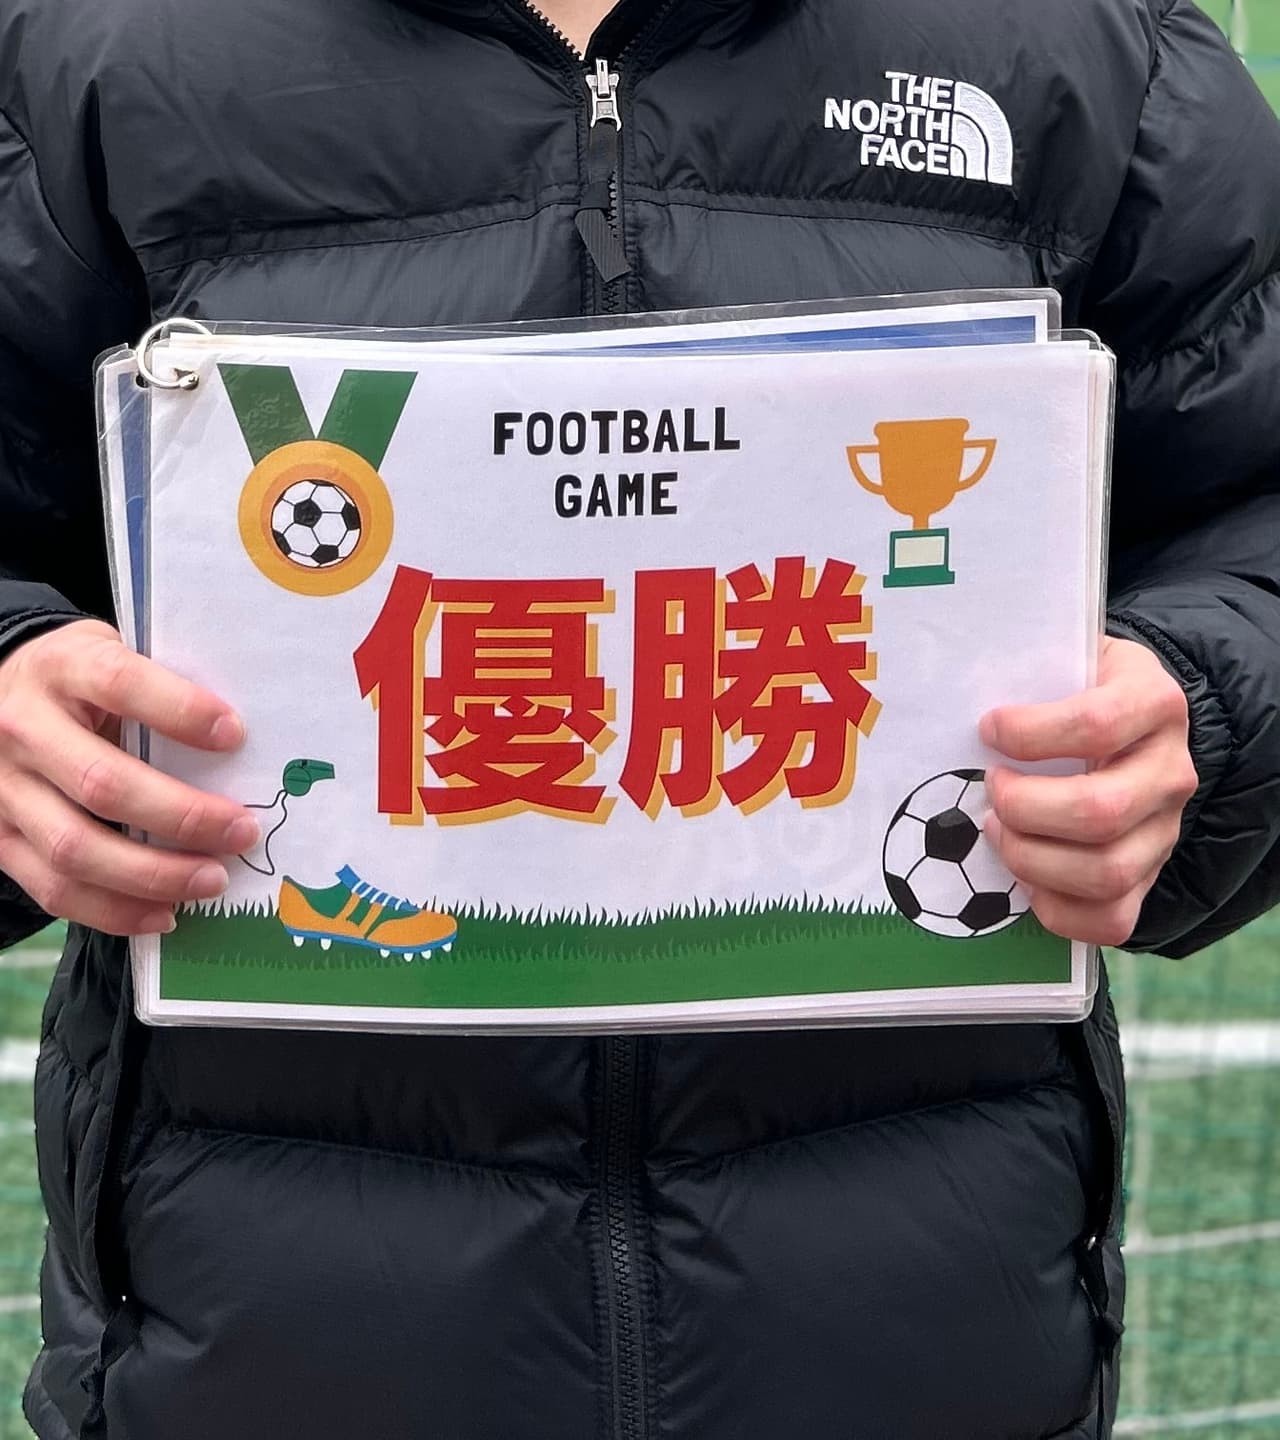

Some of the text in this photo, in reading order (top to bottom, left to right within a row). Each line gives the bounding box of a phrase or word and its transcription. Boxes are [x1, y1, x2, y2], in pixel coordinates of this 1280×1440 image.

[885, 71, 954, 111] THE
[824, 98, 951, 144] NORTH
[860, 133, 950, 176] FACE
[493, 407, 740, 456] FOOTBALL
[554, 471, 678, 518] GAME
[352, 555, 883, 827] 優勝
